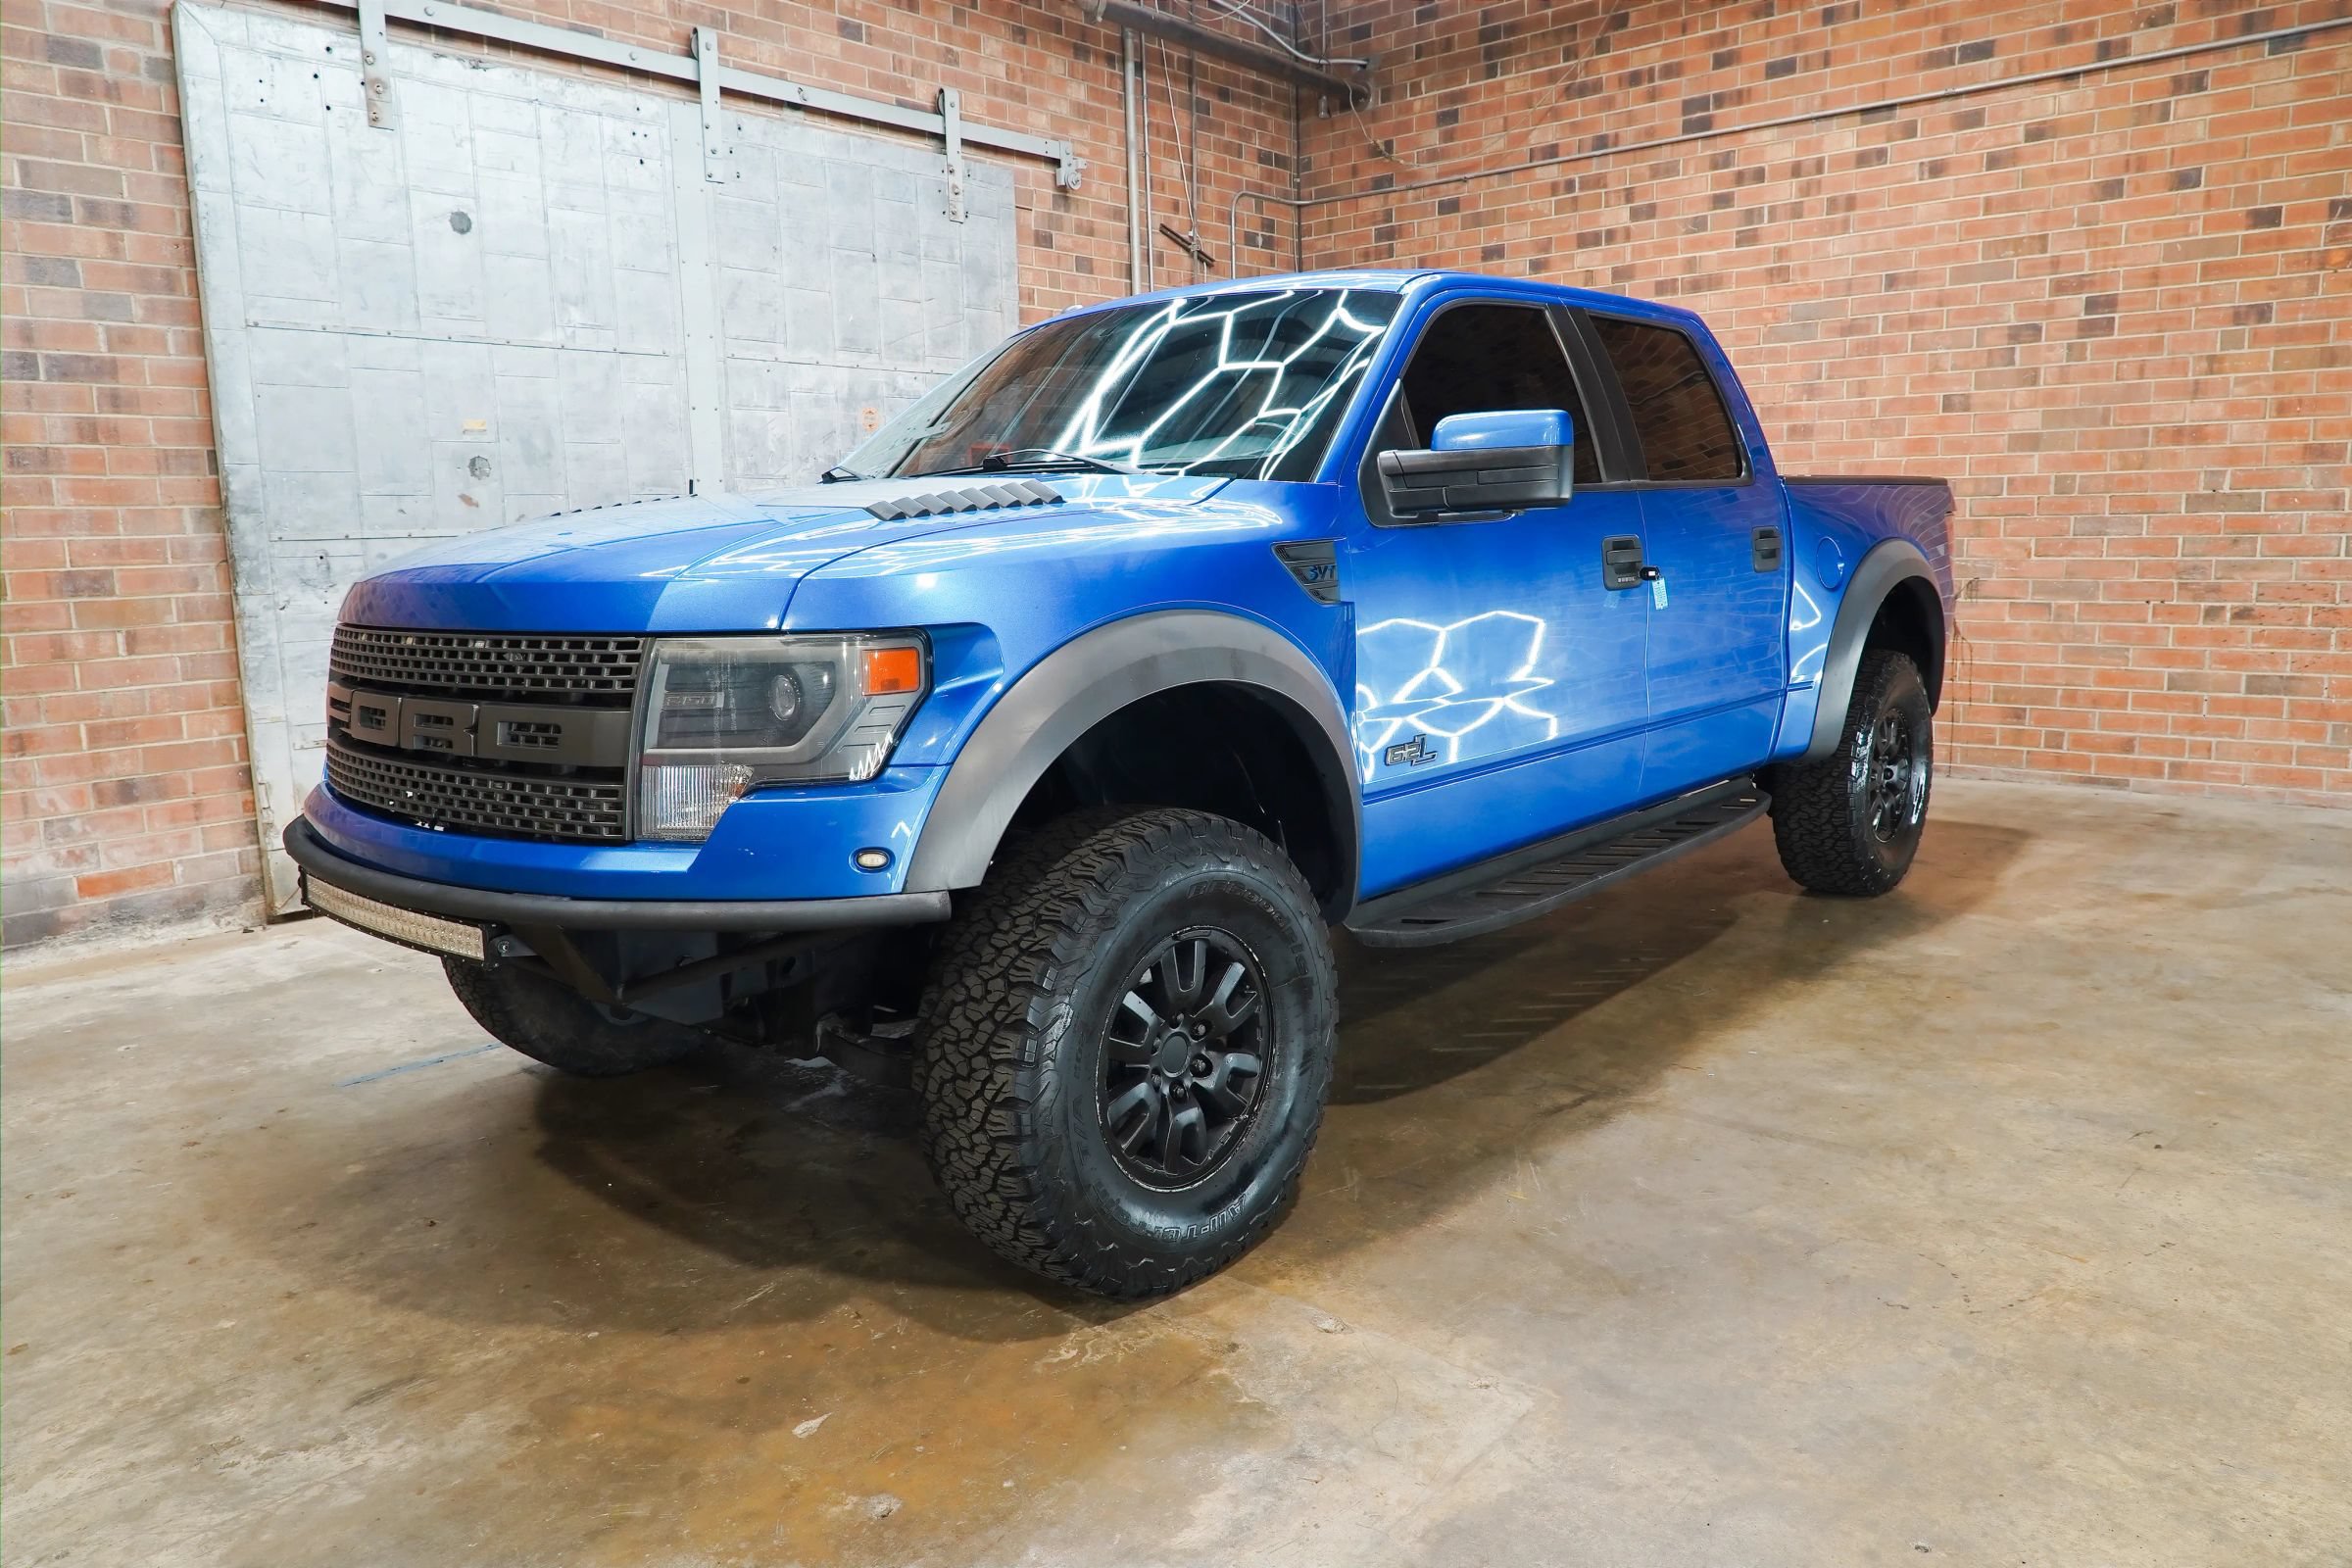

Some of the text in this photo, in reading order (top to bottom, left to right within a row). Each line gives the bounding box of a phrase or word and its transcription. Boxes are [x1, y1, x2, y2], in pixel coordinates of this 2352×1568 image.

[1308, 564, 1337, 580] SVT
[327, 682, 603, 761] FORD
[1384, 733, 1439, 767] 6.2L
